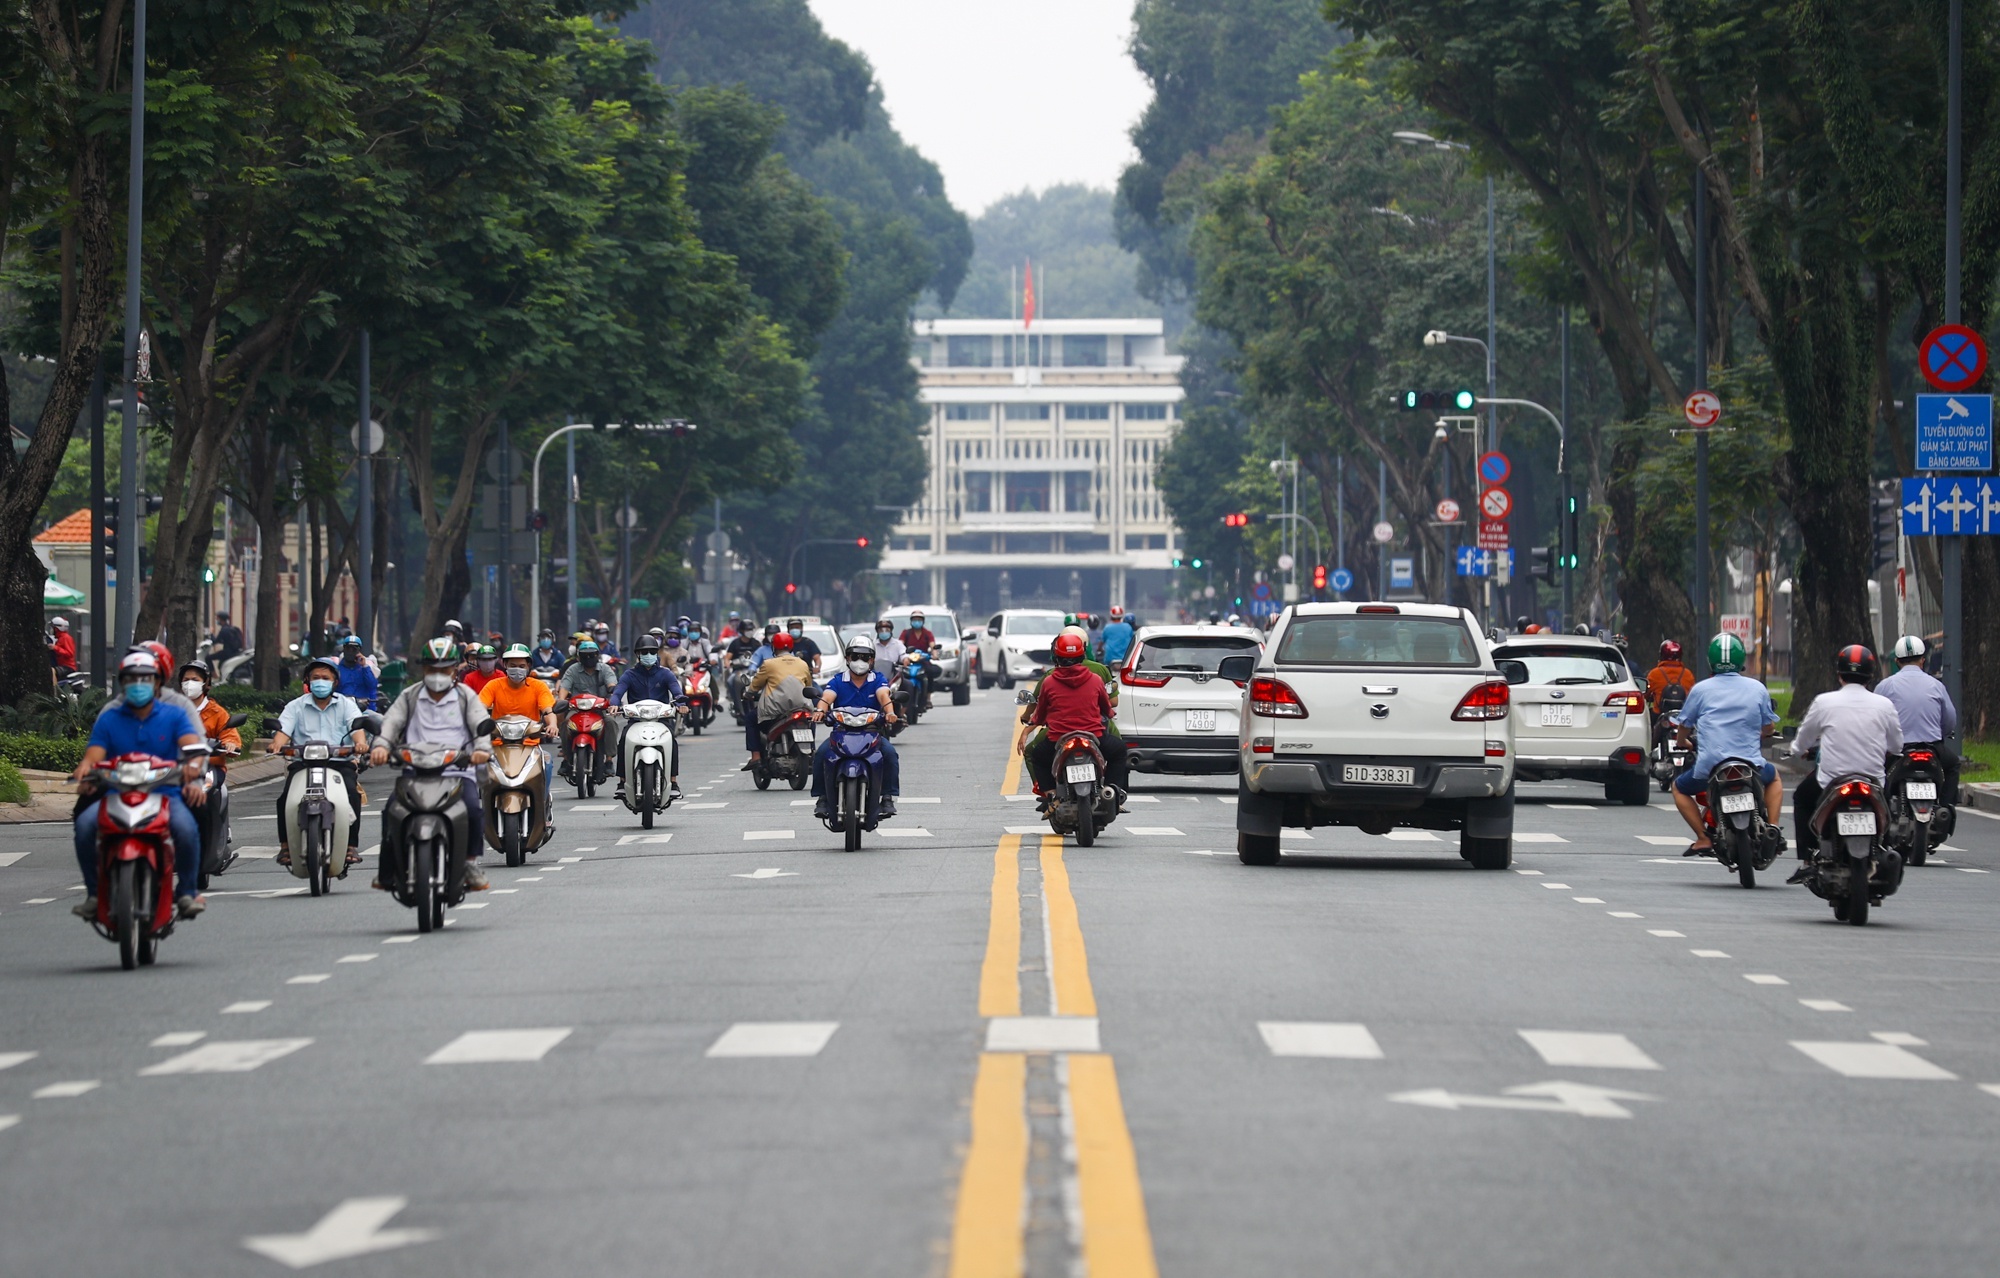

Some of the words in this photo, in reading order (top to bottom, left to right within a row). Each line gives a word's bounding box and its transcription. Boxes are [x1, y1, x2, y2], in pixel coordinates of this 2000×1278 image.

[1924, 422, 1947, 437] TUYẾN
[1948, 424, 1974, 438] ĐƯỜNG
[1975, 424, 1985, 438] CÓ
[1920, 439, 1939, 452] GIÁM
[1968, 440, 1988, 455] PHẠT
[1950, 456, 1980, 467] CAMERA
[1549, 704, 1565, 715] 51F
[1192, 711, 1209, 720] 51G
[1345, 767, 1410, 783] 51D-338.31
[1726, 795, 1748, 804] 59-P1
